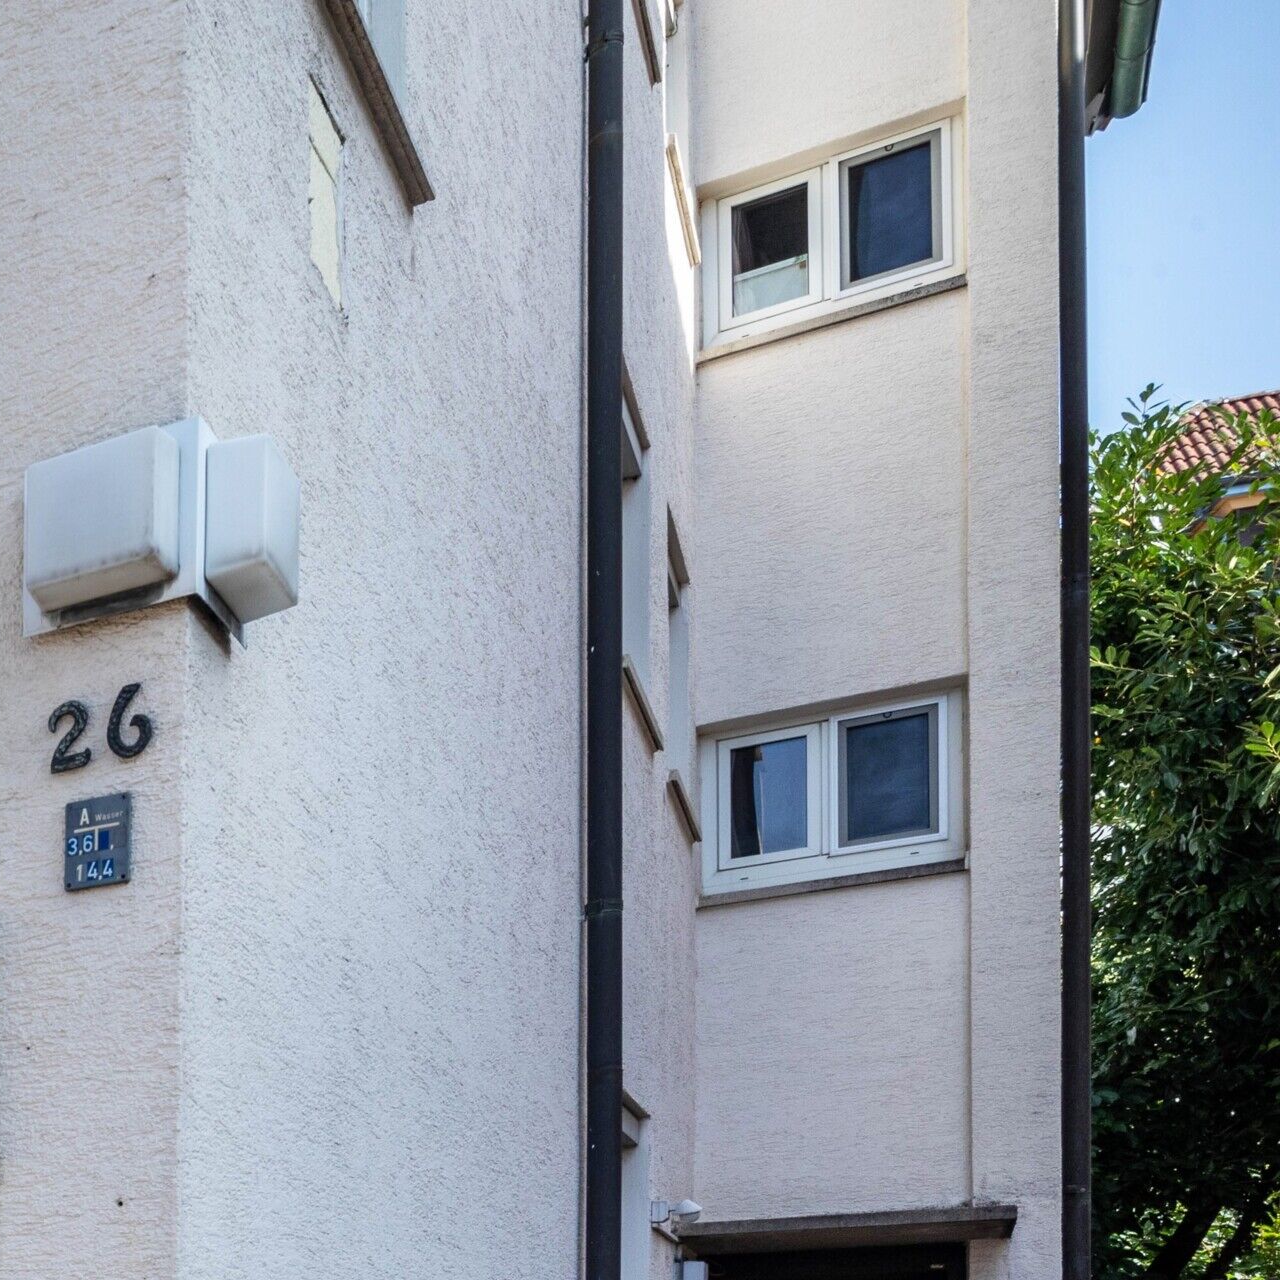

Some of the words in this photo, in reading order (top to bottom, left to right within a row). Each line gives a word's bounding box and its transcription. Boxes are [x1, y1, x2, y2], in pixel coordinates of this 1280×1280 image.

[48, 682, 152, 773] 26
[80, 808, 90, 826] A
[95, 811, 124, 822] Wasser
[68, 835, 93, 855] 3,6
